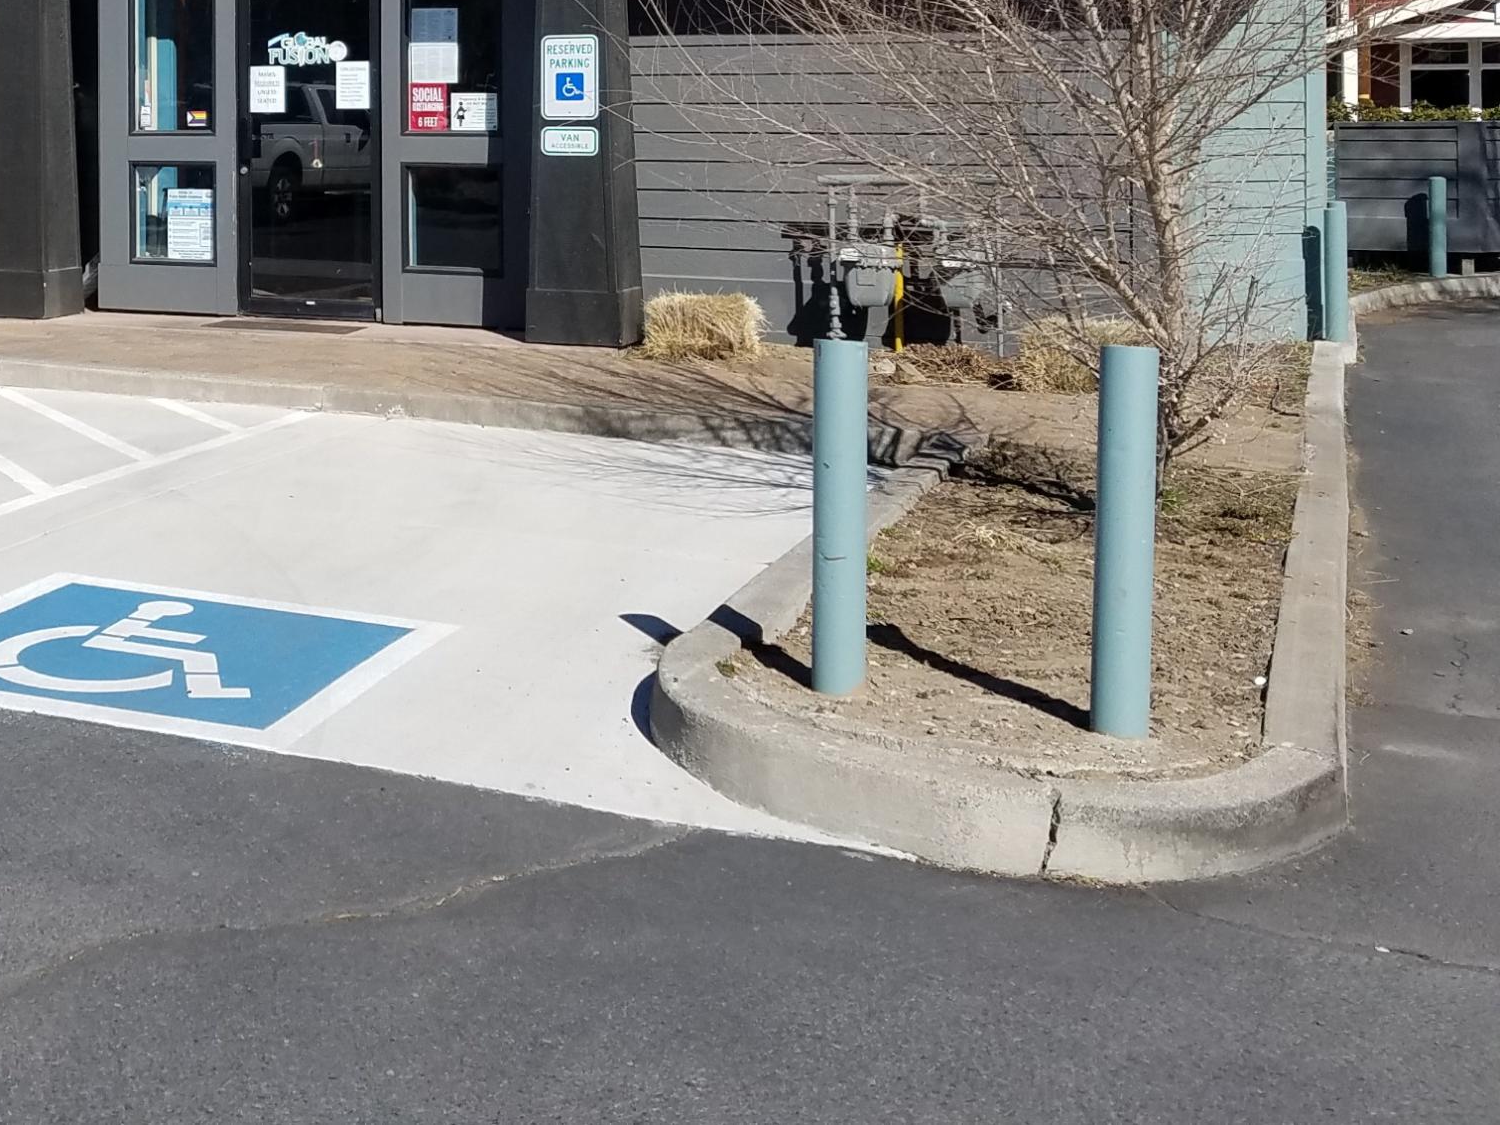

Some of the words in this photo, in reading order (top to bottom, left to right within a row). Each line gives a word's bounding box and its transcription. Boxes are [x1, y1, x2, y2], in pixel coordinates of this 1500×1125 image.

[547, 44, 593, 55] RESERVED
[268, 48, 330, 66] FUSION
[549, 58, 590, 68] PARKING
[412, 87, 444, 102] SOCIAL
[418, 117, 423, 127] 6
[424, 117, 439, 127] FEET
[560, 134, 580, 142] VAN
